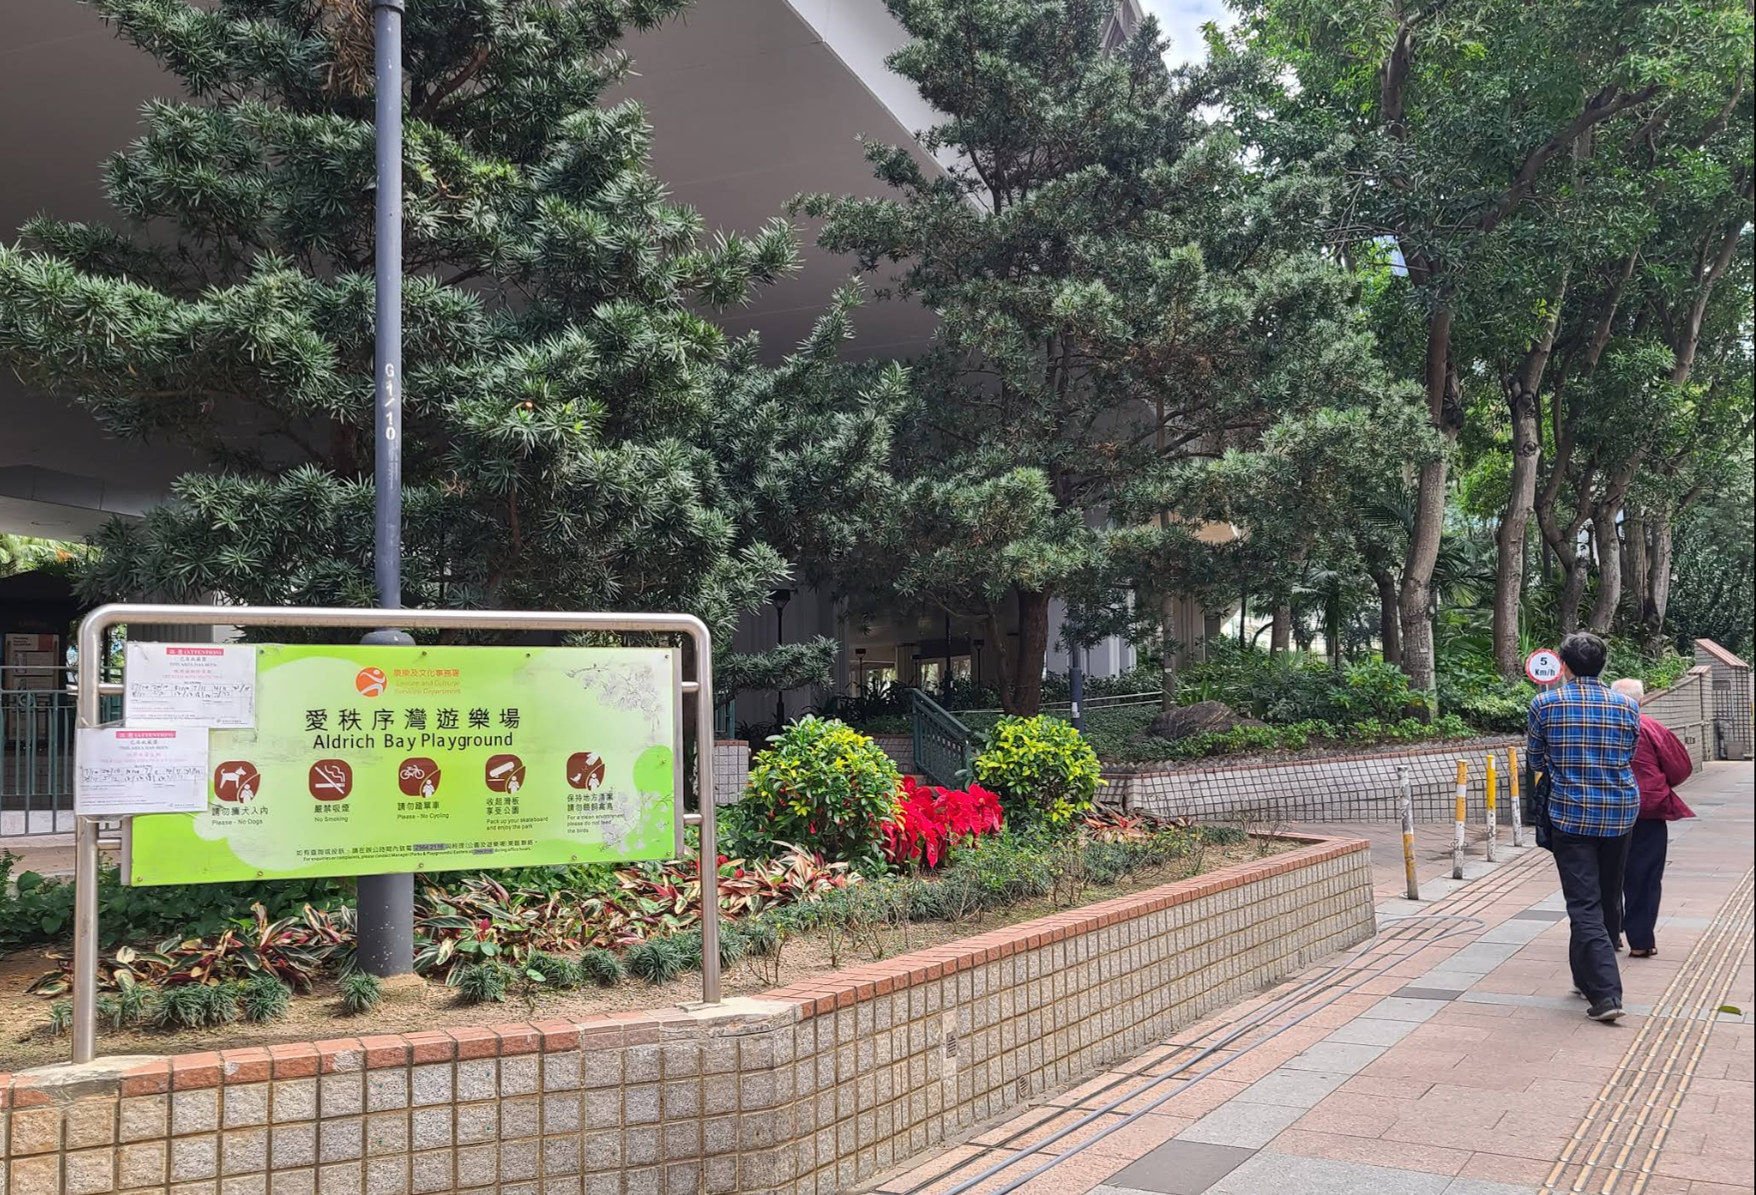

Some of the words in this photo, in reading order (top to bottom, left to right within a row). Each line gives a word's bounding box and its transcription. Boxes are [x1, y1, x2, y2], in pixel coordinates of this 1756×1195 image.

[384, 363, 396, 440] G1/10
[1540, 657, 1548, 666] 5
[1534, 668, 1556, 676] Km/h
[304, 707, 521, 732] 愛秩序灣遊樂場
[313, 734, 375, 749] Aldrich
[383, 733, 417, 751] Bay
[421, 731, 514, 751] Playground
[429, 812, 450, 820] Cycling
